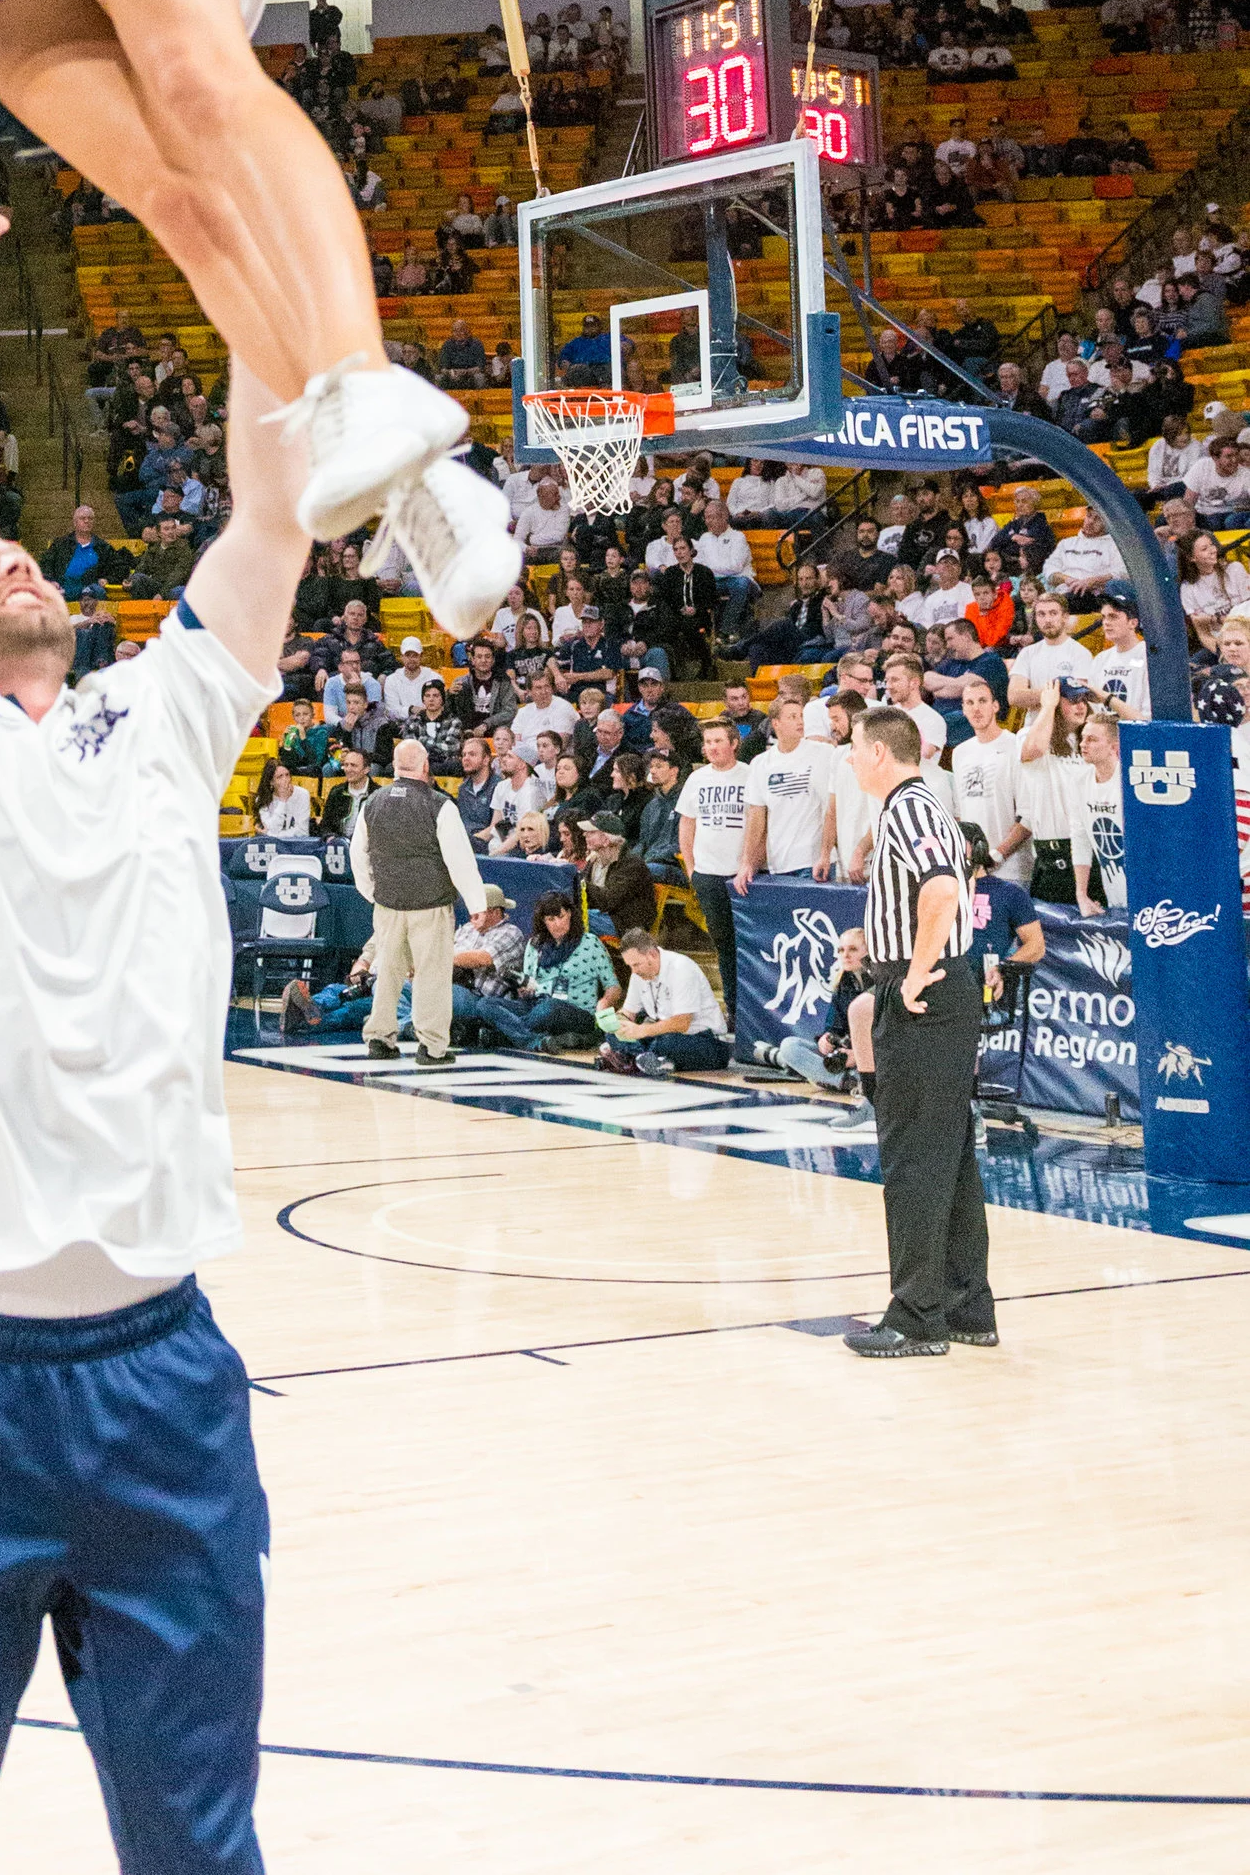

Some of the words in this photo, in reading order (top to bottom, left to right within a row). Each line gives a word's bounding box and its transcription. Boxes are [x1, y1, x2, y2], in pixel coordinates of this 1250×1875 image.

[686, 54, 755, 154] 30
[790, 67, 863, 107] 11:51
[804, 109, 849, 160] 30
[899, 414, 984, 451] FIRST
[698, 785, 746, 805] STRIPE
[711, 804, 745, 815] STADIUM
[1027, 987, 1136, 1027] ermo
[1034, 1026, 1137, 1069] Region
